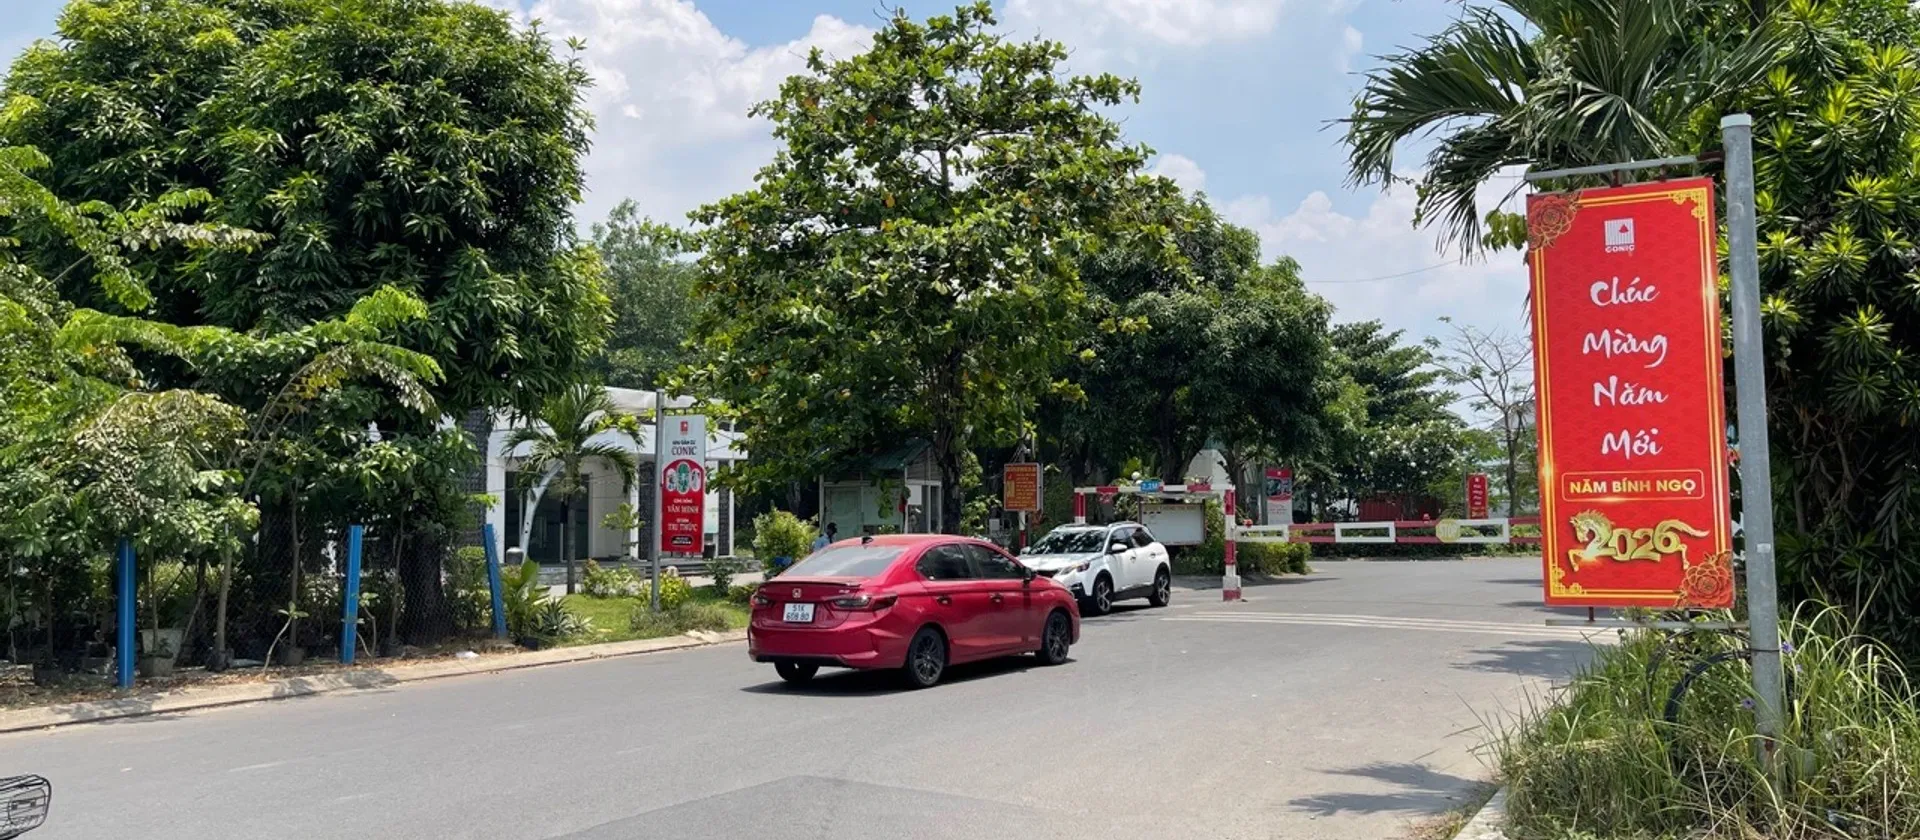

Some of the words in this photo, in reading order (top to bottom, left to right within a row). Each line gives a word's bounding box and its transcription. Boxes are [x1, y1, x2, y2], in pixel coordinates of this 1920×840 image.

[1605, 244, 1635, 253] CONIC
[1590, 276, 1660, 307] Chúc
[1582, 328, 1668, 368] Mừng
[1593, 375, 1669, 407] Năm
[671, 446, 697, 456] CONIC
[1601, 428, 1663, 460] Mới
[1570, 478, 1607, 494] NĂM
[1612, 477, 1651, 493] BÍNH
[1656, 478, 1696, 495] NGỌ
[1572, 510, 1686, 563] 2026
